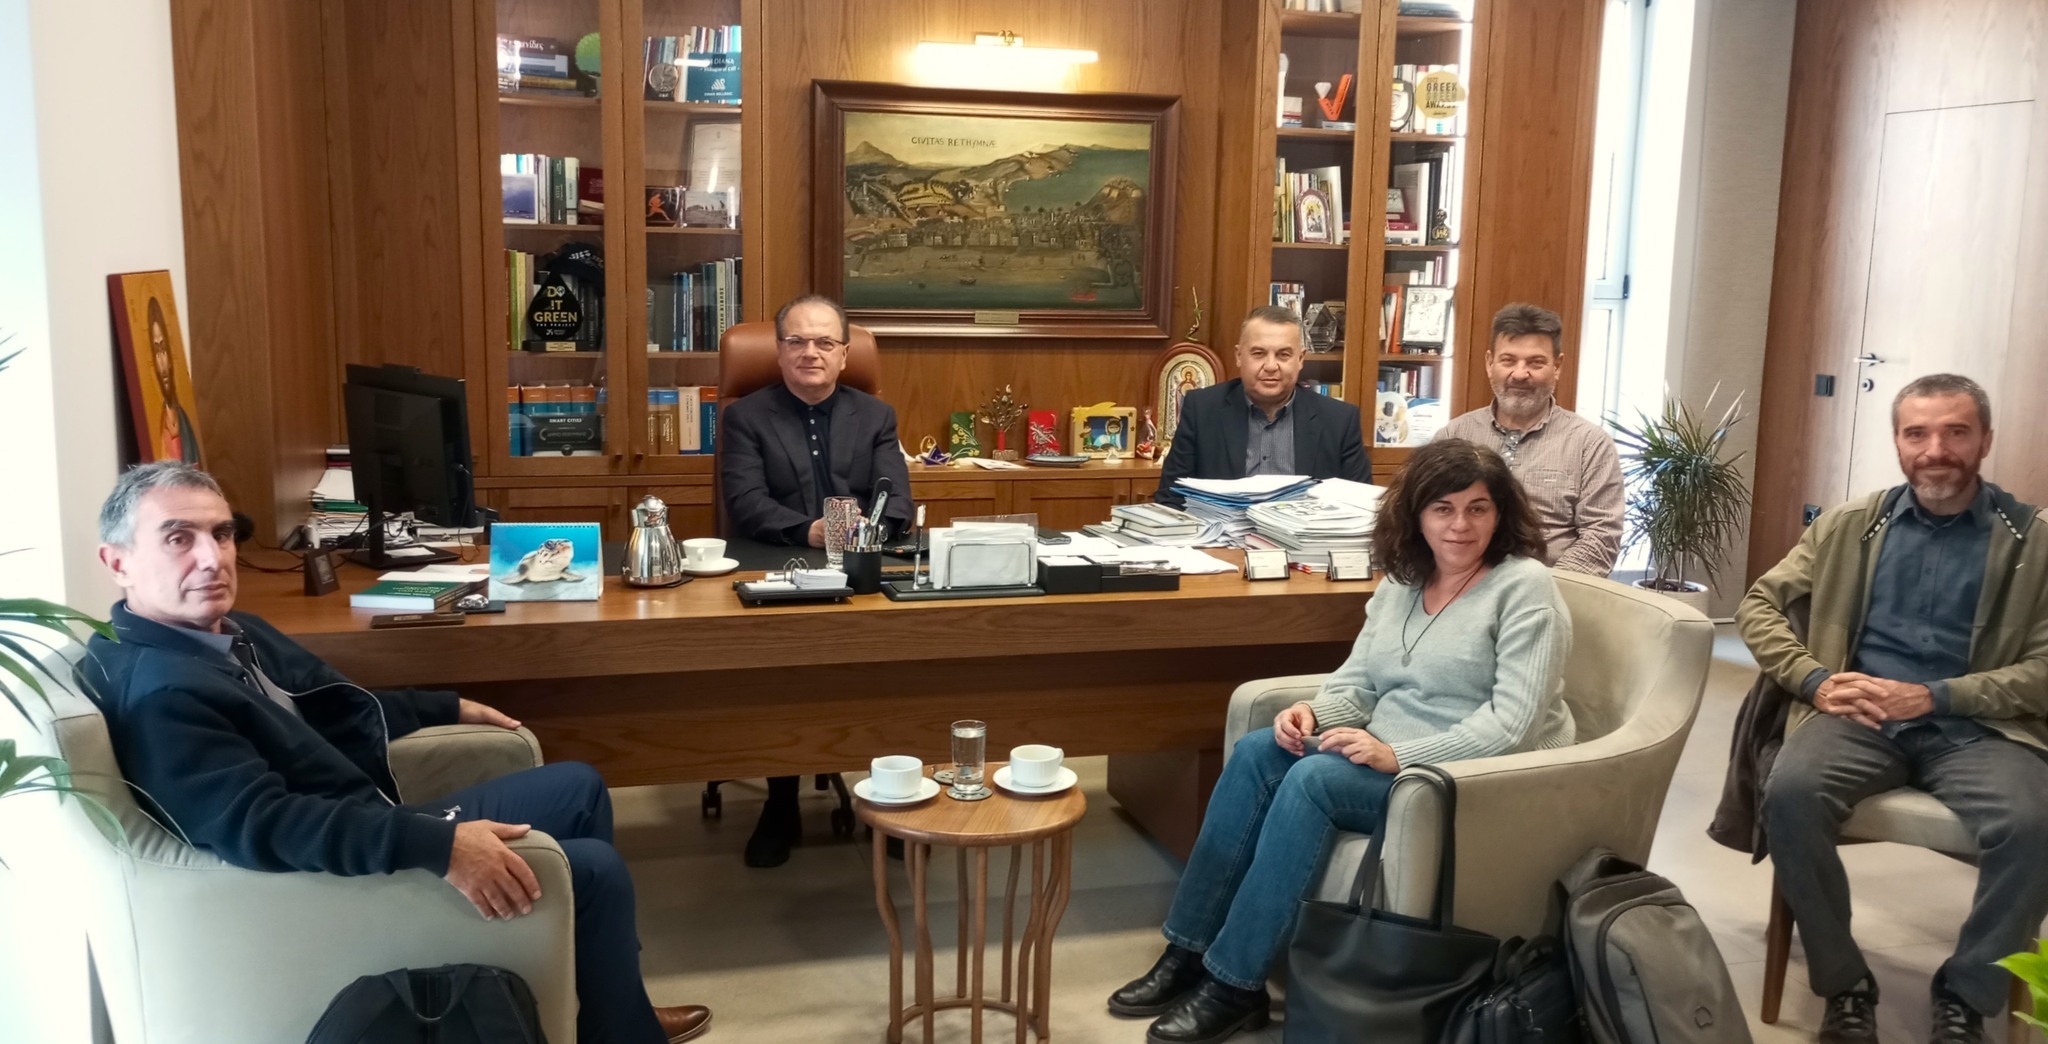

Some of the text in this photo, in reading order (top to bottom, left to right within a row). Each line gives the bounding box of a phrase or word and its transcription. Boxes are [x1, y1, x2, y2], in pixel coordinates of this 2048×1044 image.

[1426, 82, 1457, 91] GREEK
[911, 136, 944, 146] CIVITAS
[533, 311, 578, 323] GREEN
